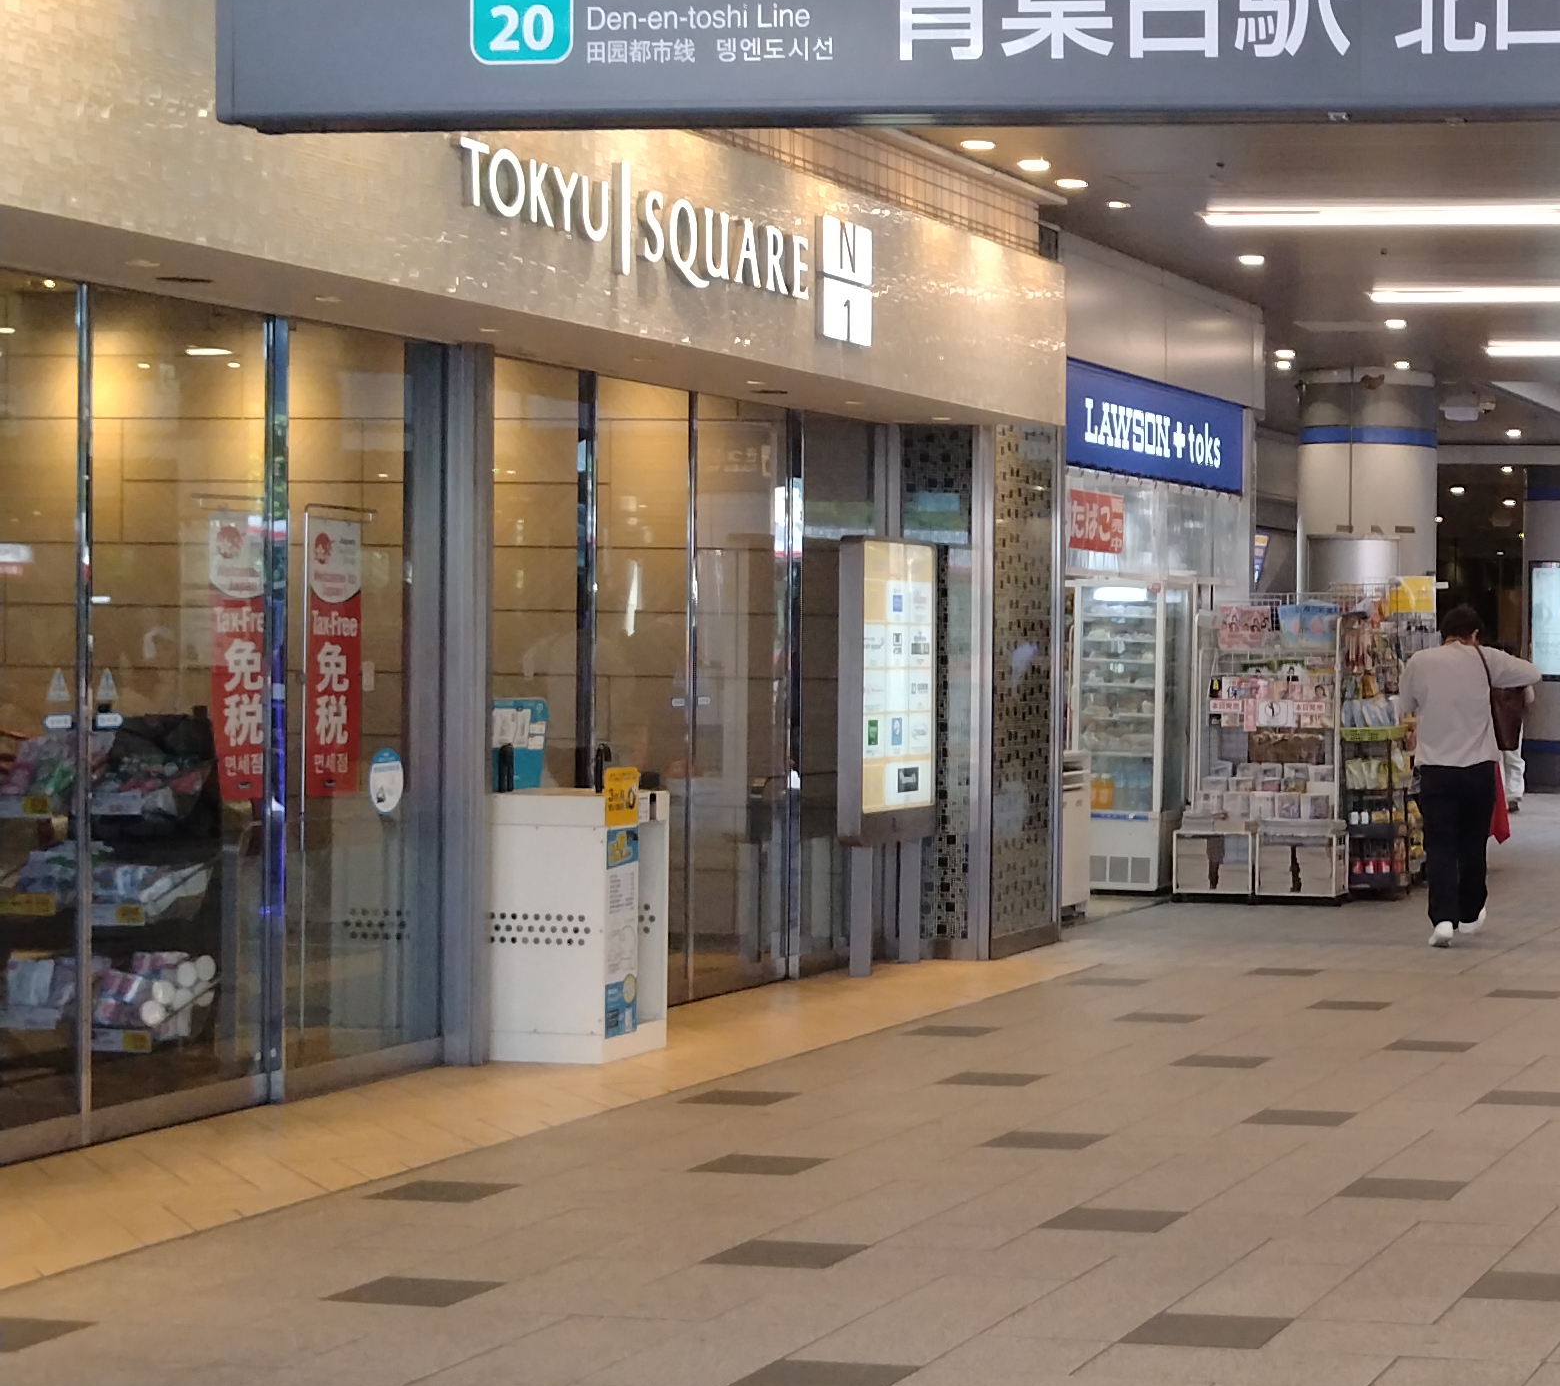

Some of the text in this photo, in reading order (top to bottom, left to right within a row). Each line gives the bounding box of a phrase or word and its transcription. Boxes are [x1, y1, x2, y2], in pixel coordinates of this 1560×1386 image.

[488, 4, 555, 52] 20
[586, 3, 811, 31] Den-en-toshi Line
[586, 38, 697, 65] 田园都市线
[716, 36, 834, 63] 뎅엔도시선
[458, 136, 810, 300] TOKYU SQUARE
[1084, 397, 1171, 458] LAWSON
[1187, 422, 1222, 469] toks
[1071, 500, 1110, 541] たばこ
[213, 606, 264, 633] Tax-Fre
[312, 610, 358, 638] Tax-Free
[315, 641, 349, 746] 免税
